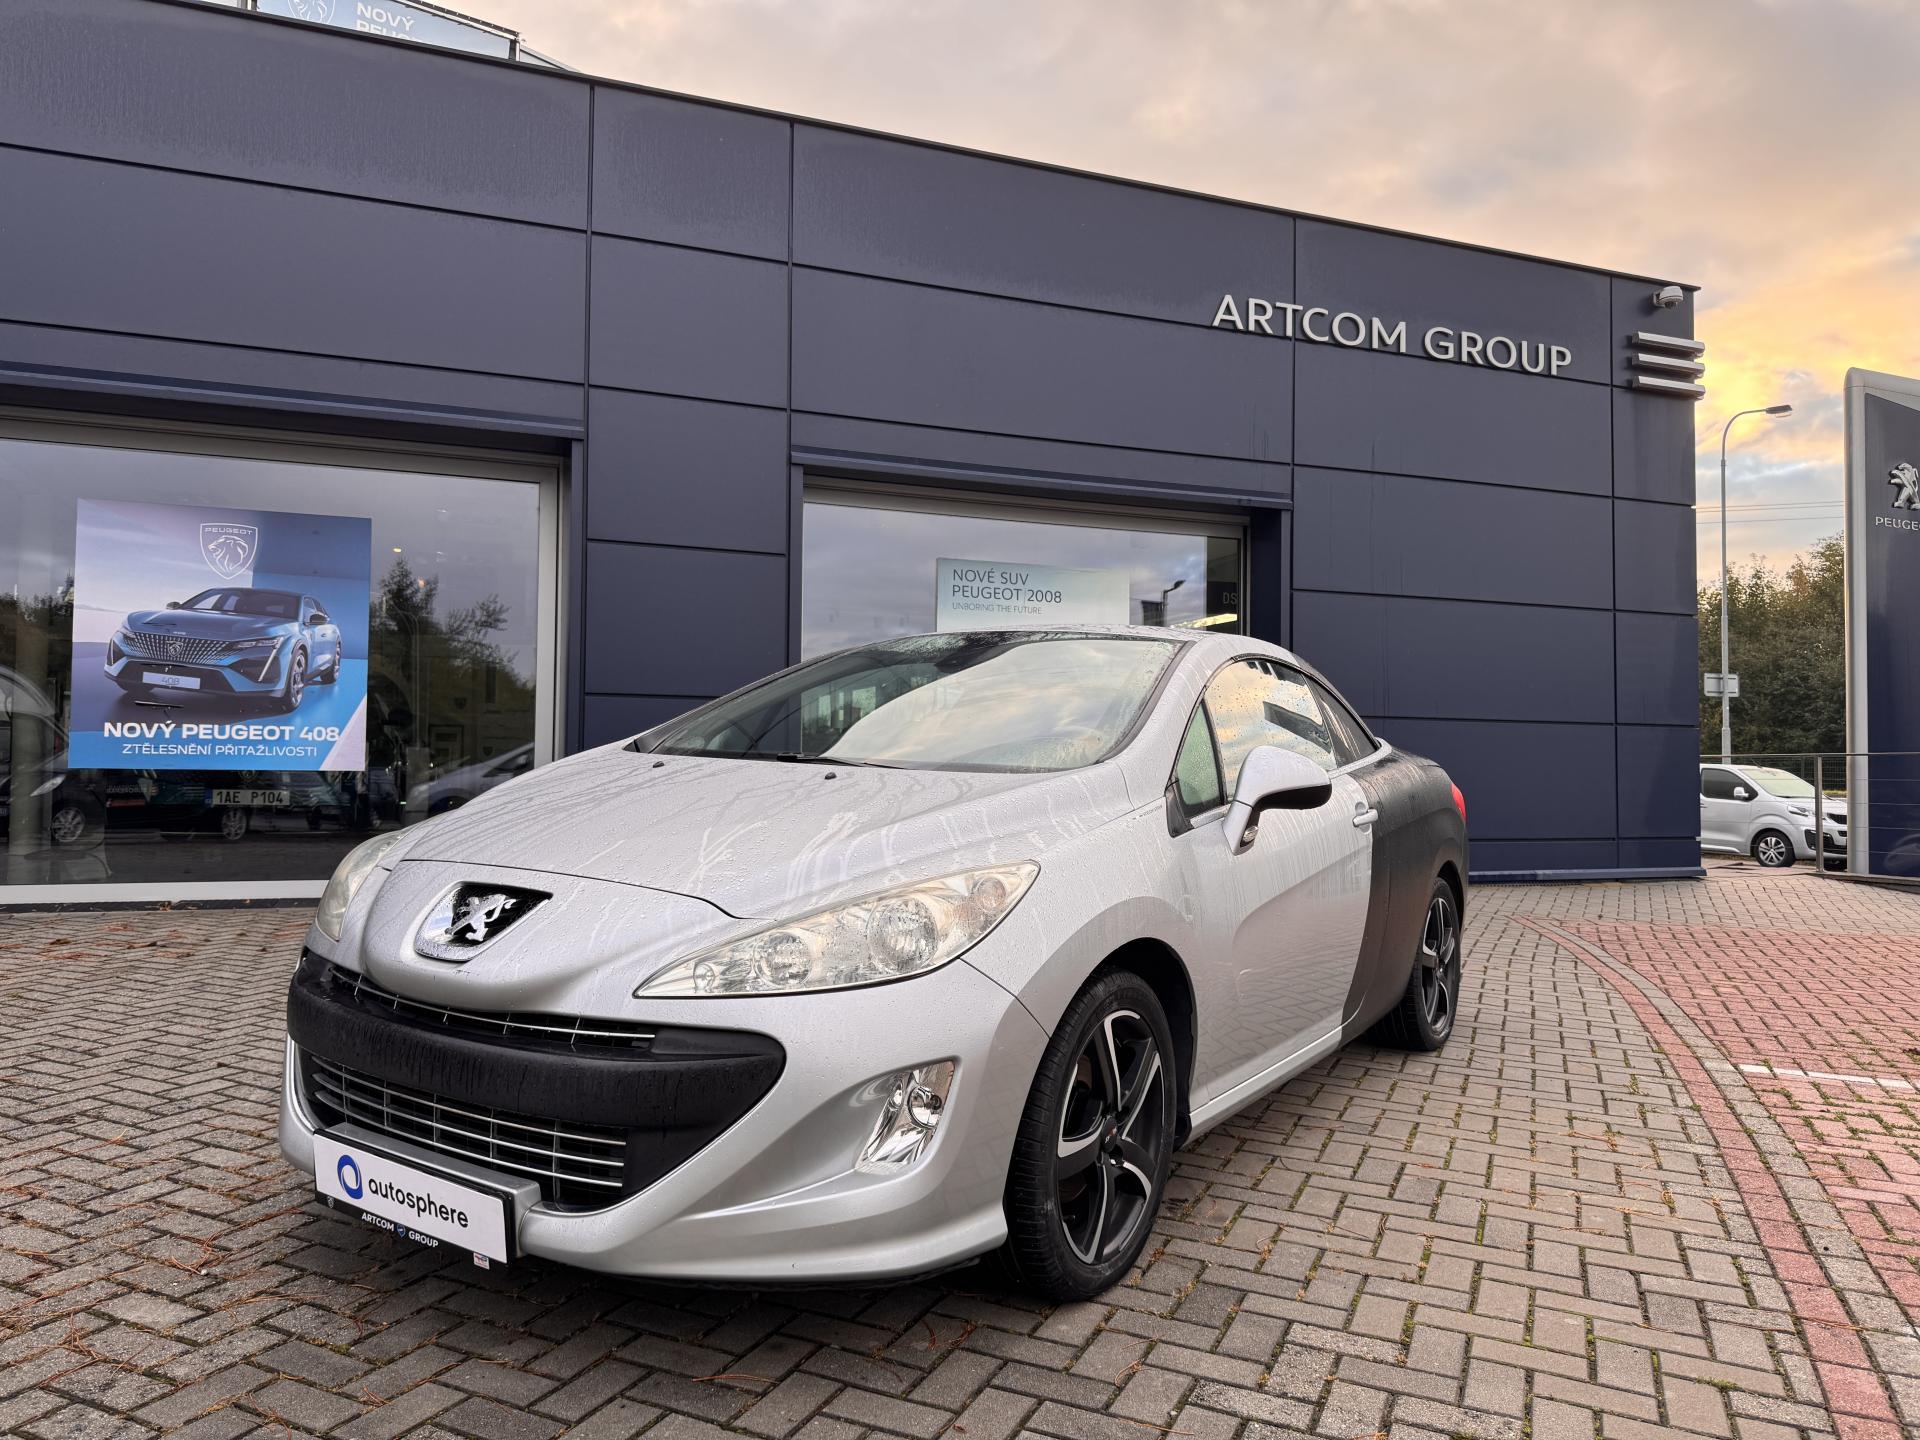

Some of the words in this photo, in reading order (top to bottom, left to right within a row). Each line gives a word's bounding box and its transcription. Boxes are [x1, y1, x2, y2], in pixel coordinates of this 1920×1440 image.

[356, 2, 415, 32] NOVÝ
[1212, 294, 1408, 354] ARTCOM
[1423, 326, 1572, 376] GROUP
[204, 527, 253, 535] PEUGEOT
[1875, 516, 1920, 531] PEUGE
[952, 568, 996, 584] NOVÉ
[1000, 571, 1029, 586] SUV
[952, 584, 1022, 601] PEUGEOT
[1026, 589, 1062, 604] 2008
[952, 602, 995, 613] UNBORING
[997, 604, 1012, 613] THE
[1013, 605, 1042, 615] FUTURE
[161, 676, 180, 686] 408
[103, 720, 176, 739] NOVÝ
[181, 724, 295, 741] PEUGEOT
[299, 725, 340, 742] 408
[122, 743, 212, 756] ZTĚLESNĚNÍ
[215, 744, 317, 757] PŘITAŽLIVOSTI
[216, 791, 241, 804] 1AE
[251, 792, 284, 804] P104
[368, 1178, 469, 1228] autosphere
[361, 1211, 395, 1232] ARTCOM
[408, 1230, 439, 1248] GROUP
